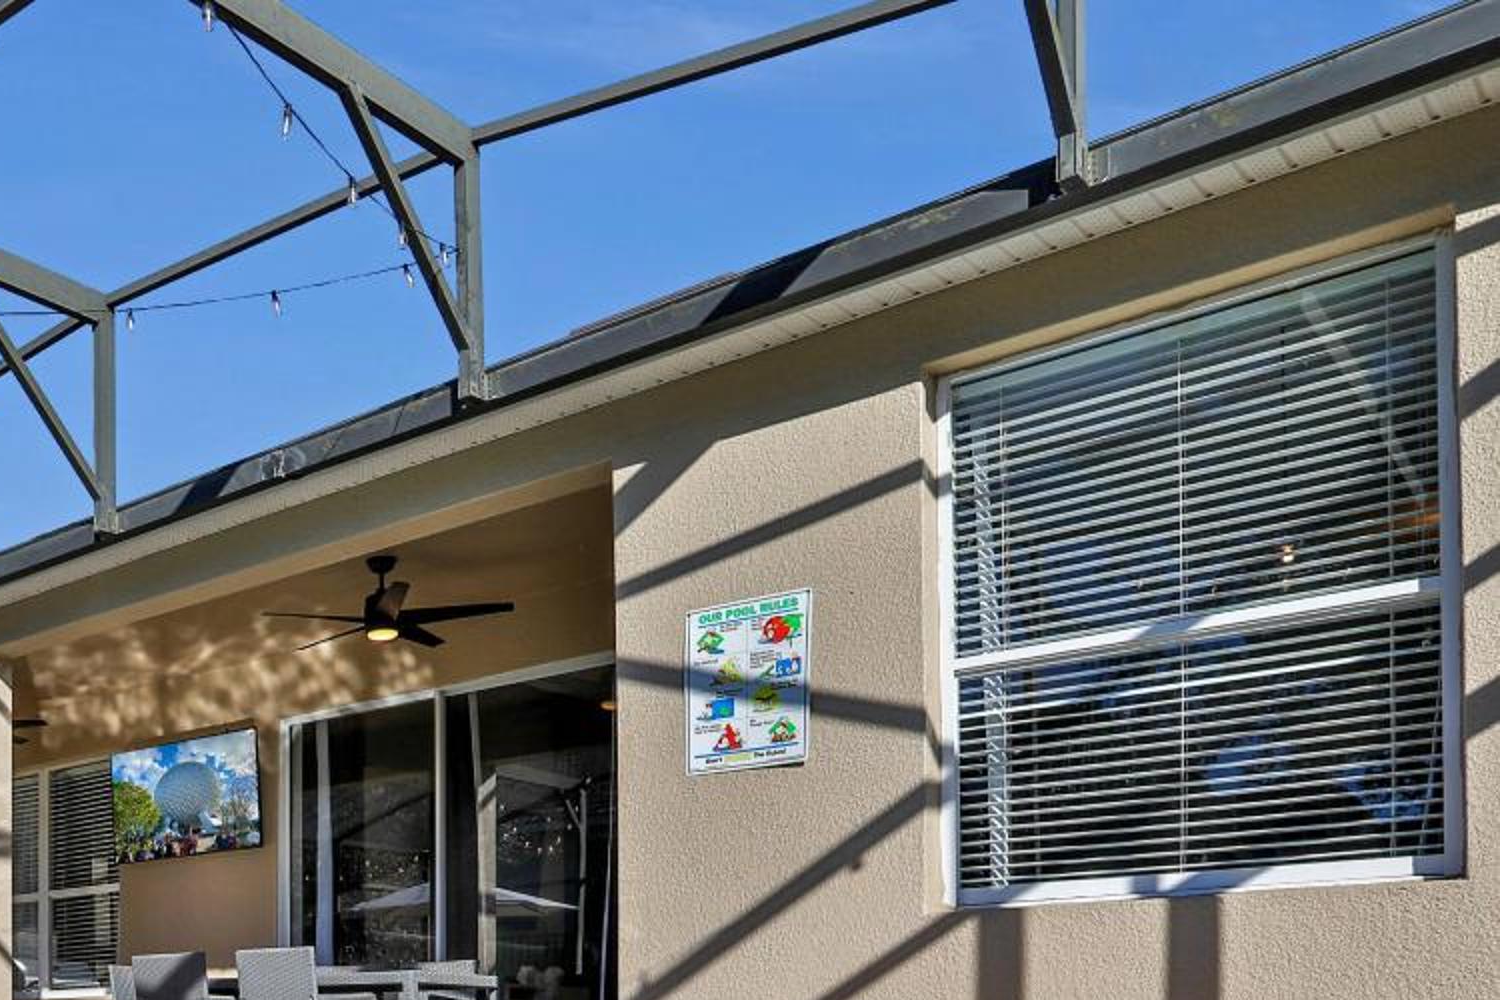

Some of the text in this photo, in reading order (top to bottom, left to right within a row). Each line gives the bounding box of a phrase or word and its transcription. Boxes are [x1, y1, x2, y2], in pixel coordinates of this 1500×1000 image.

[699, 597, 799, 625] OUR POOL RULES
